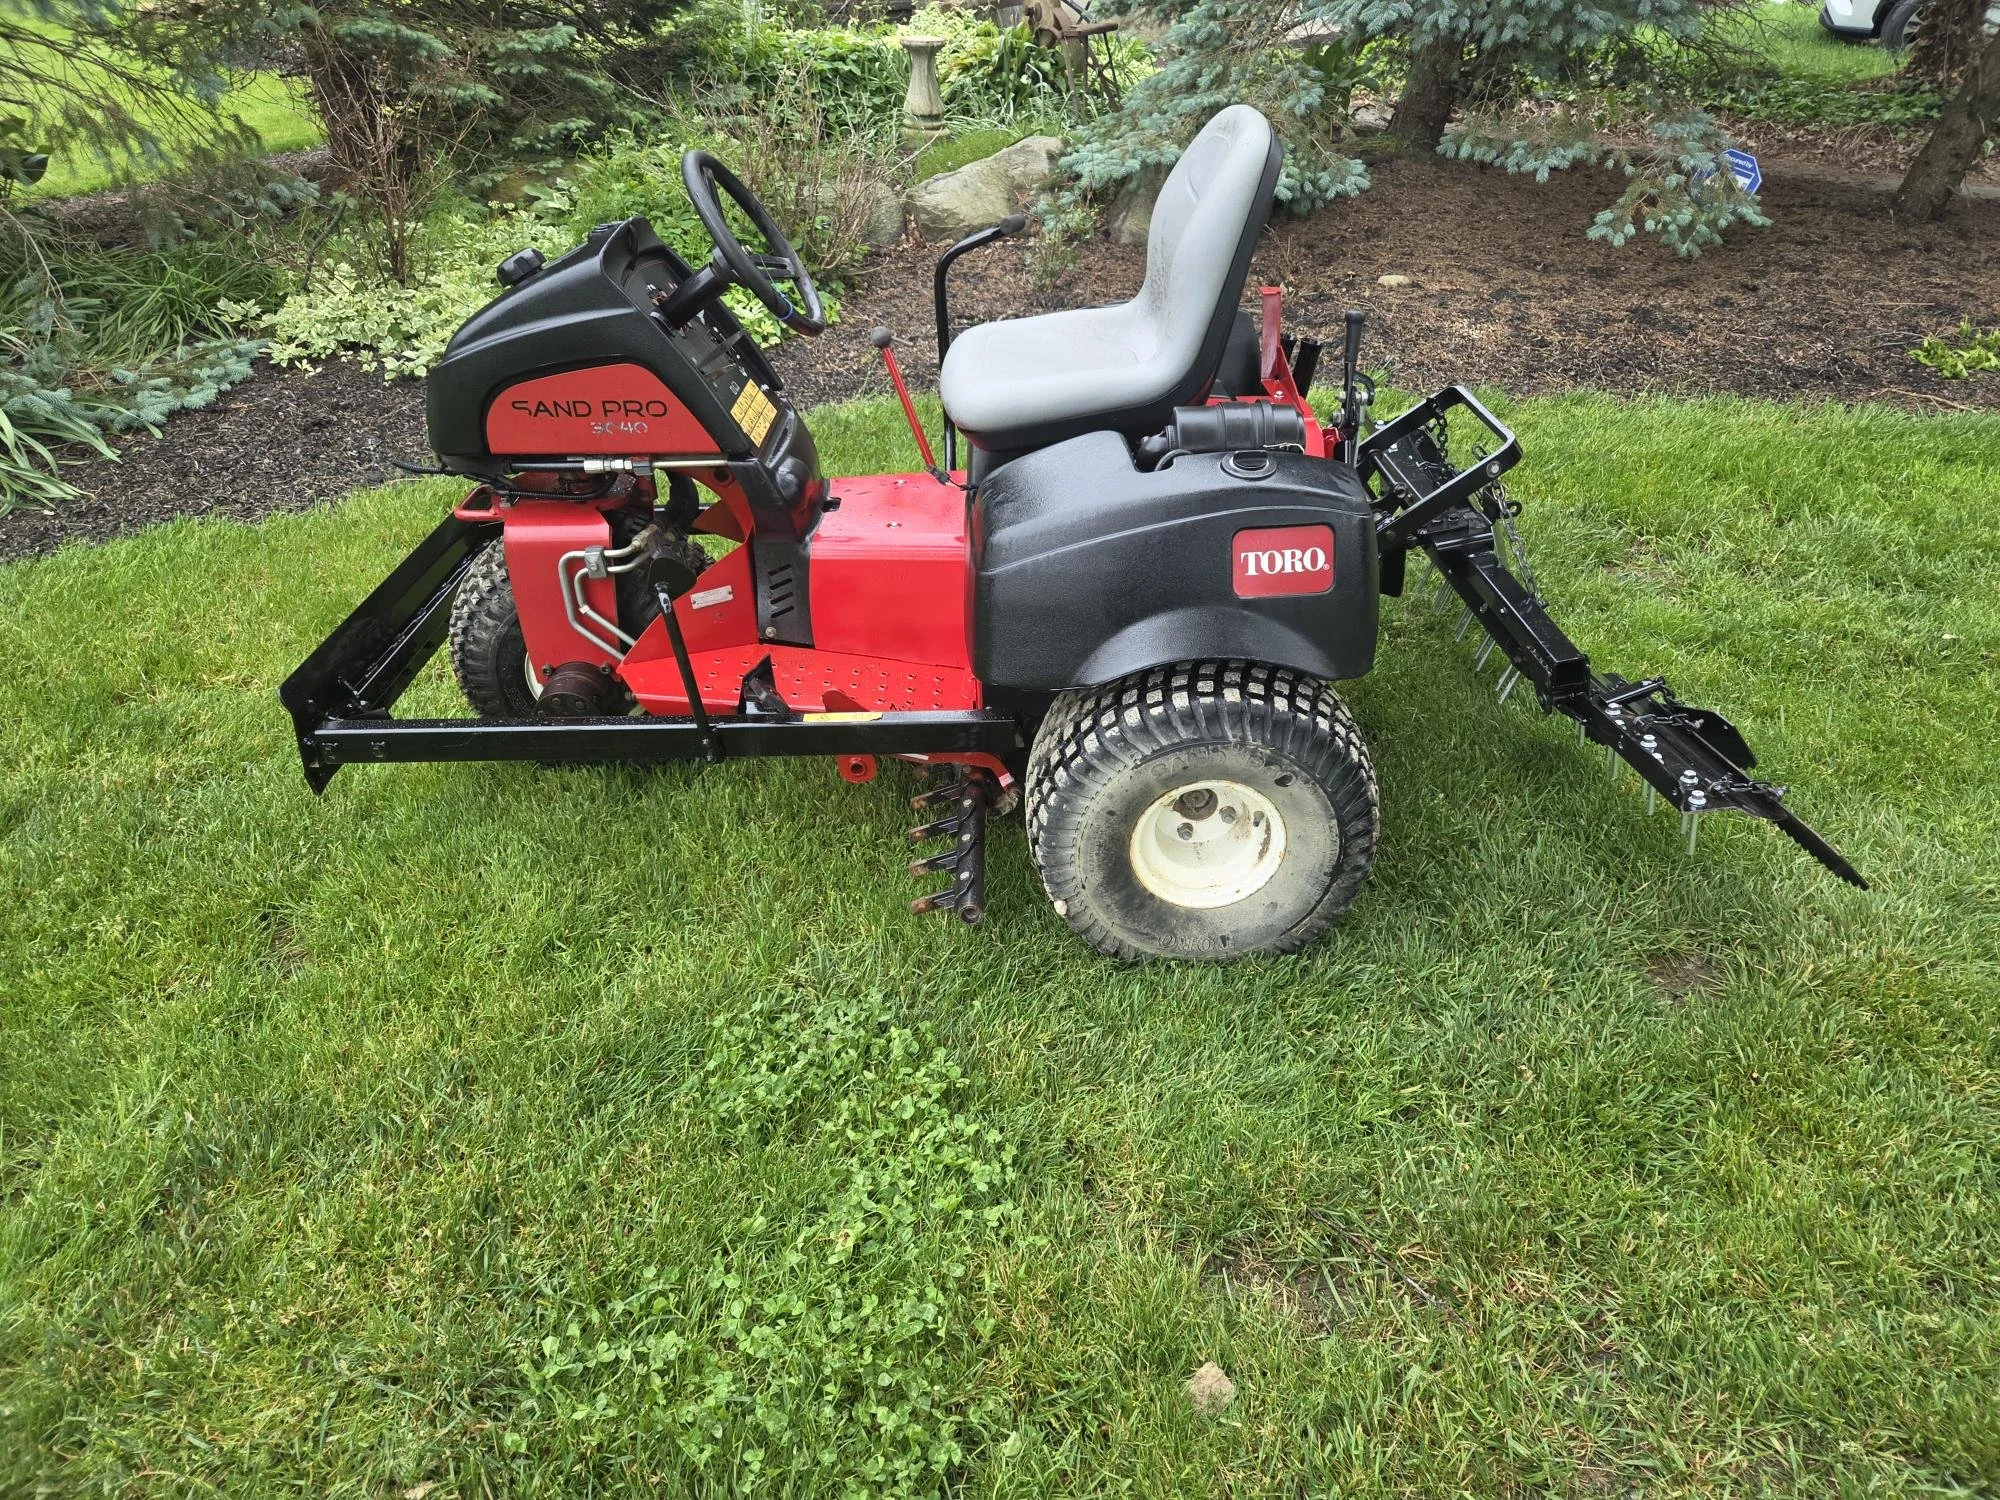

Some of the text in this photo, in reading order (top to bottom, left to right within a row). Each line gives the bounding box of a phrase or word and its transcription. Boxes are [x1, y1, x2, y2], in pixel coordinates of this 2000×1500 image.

[511, 400, 668, 417] SAND PRO
[590, 421, 649, 434] 3040
[1240, 546, 1326, 576] TORO
